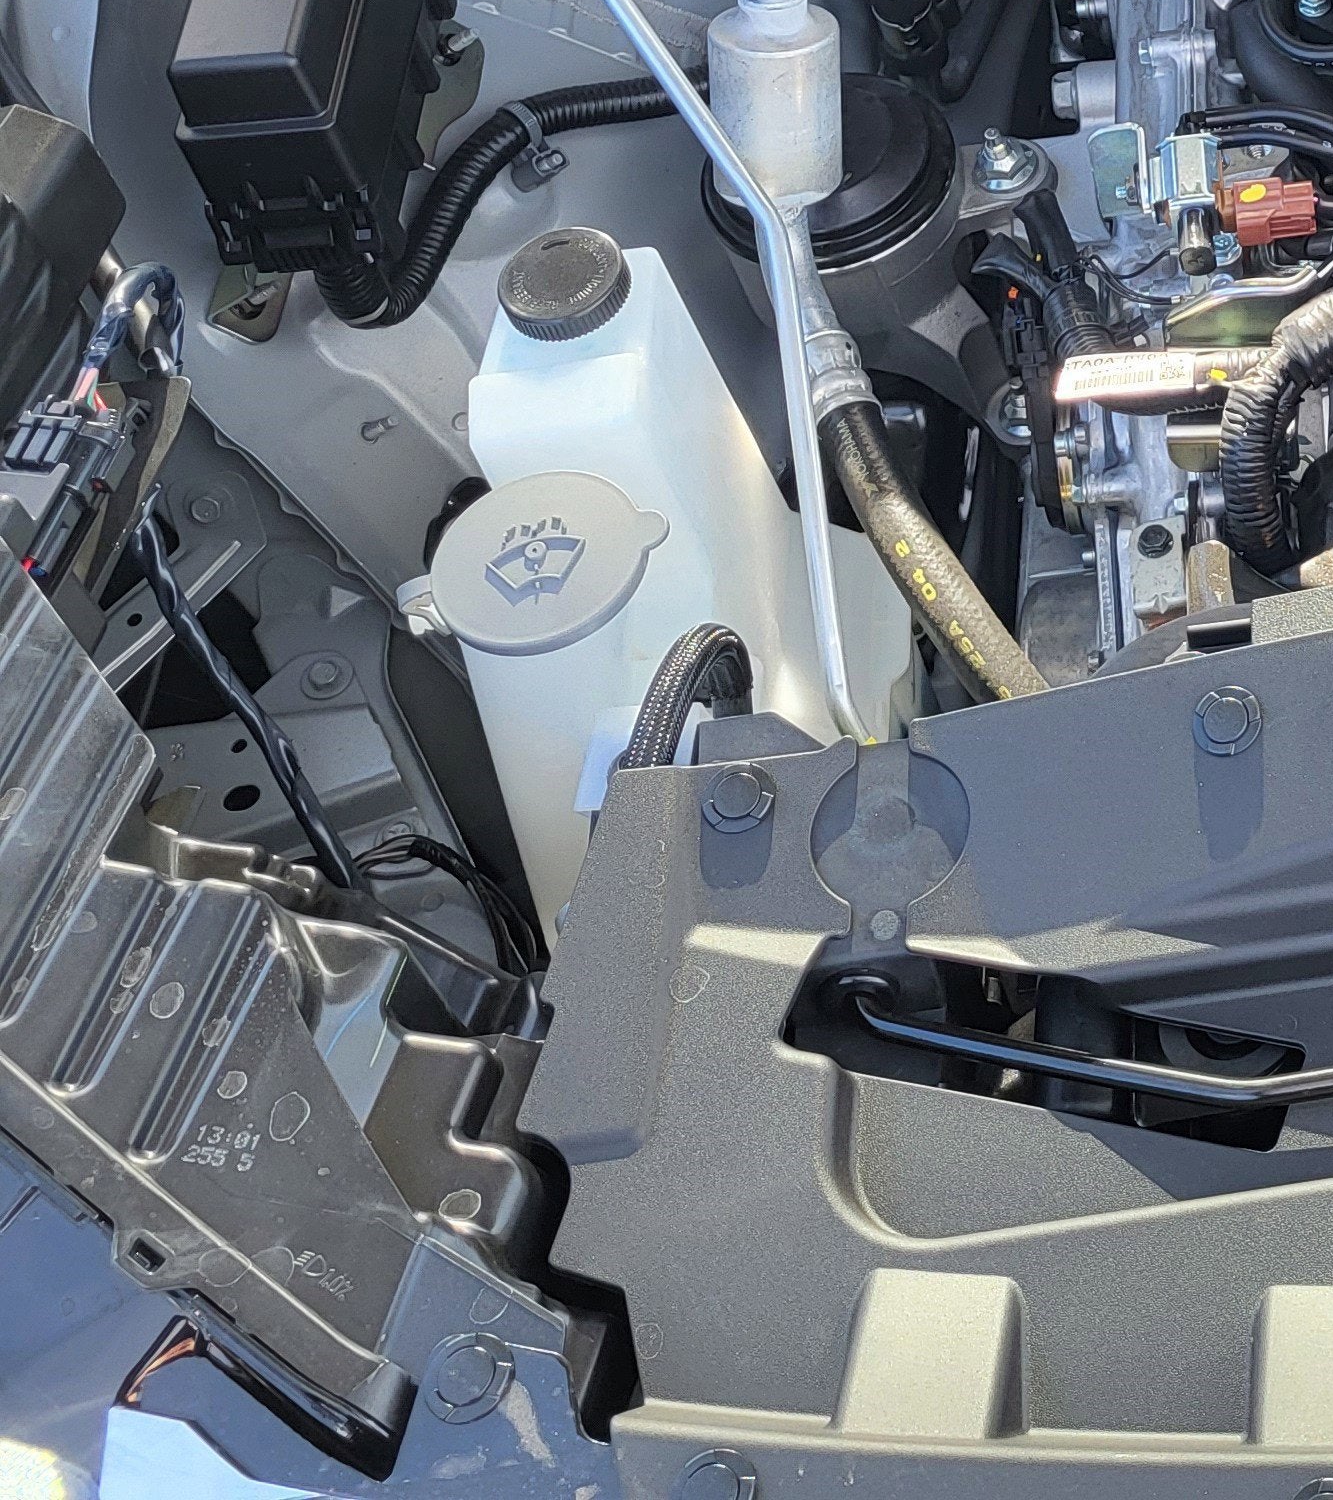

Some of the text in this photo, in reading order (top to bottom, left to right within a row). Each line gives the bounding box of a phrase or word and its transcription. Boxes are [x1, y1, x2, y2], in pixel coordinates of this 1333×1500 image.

[837, 417, 869, 481] YOKOHAMA
[894, 538, 912, 558] 2
[912, 567, 938, 602] 04
[948, 618, 987, 670] 25A
[197, 1123, 262, 1152] 13:01
[181, 1143, 257, 1173] 255 5
